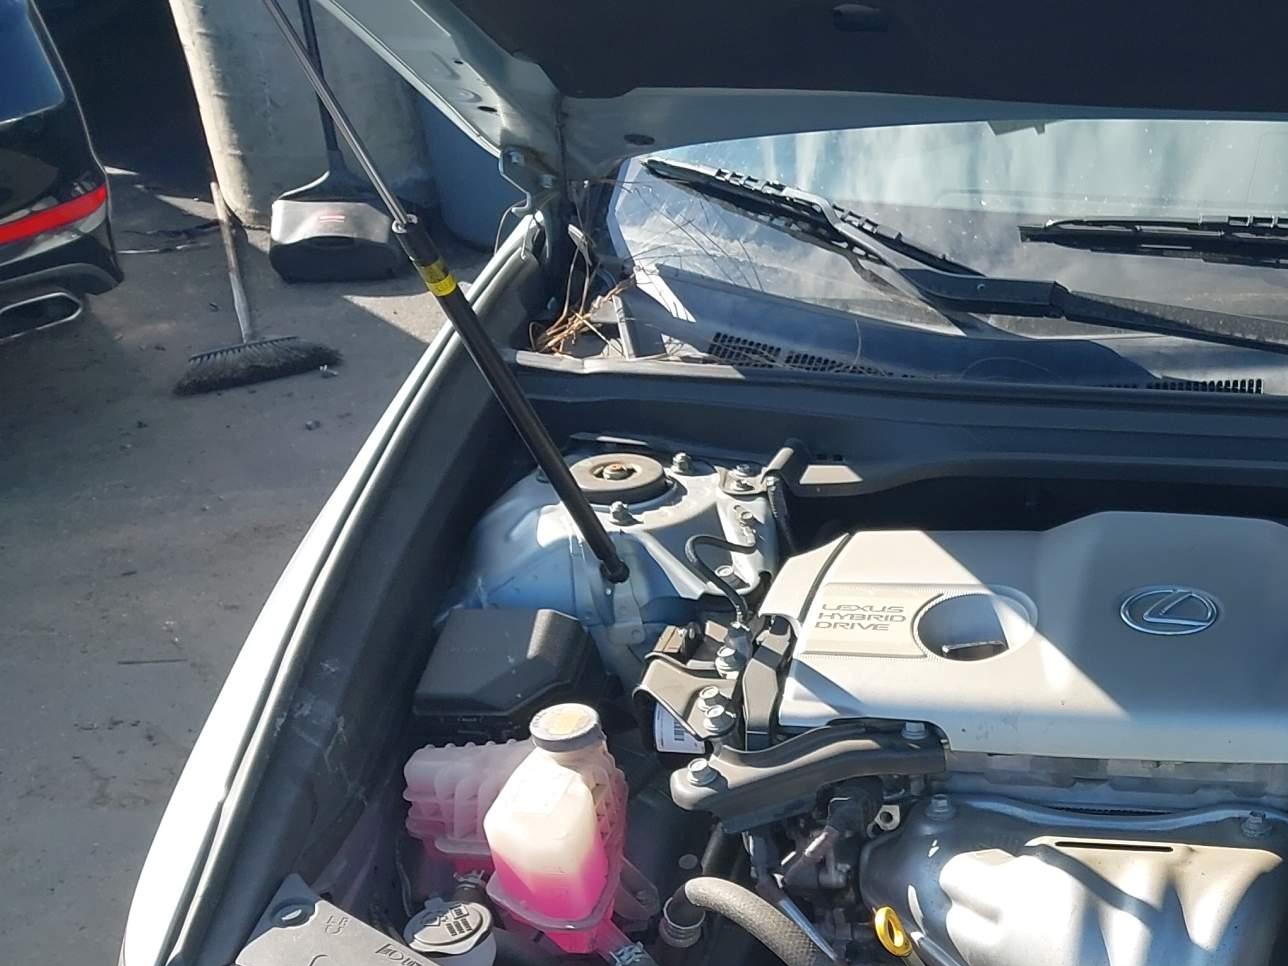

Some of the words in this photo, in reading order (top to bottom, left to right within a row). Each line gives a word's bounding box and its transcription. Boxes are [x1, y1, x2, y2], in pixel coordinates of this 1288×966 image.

[821, 604, 905, 613] LEXUS
[818, 612, 907, 622] HYBRID
[815, 621, 890, 631] DRIVE
